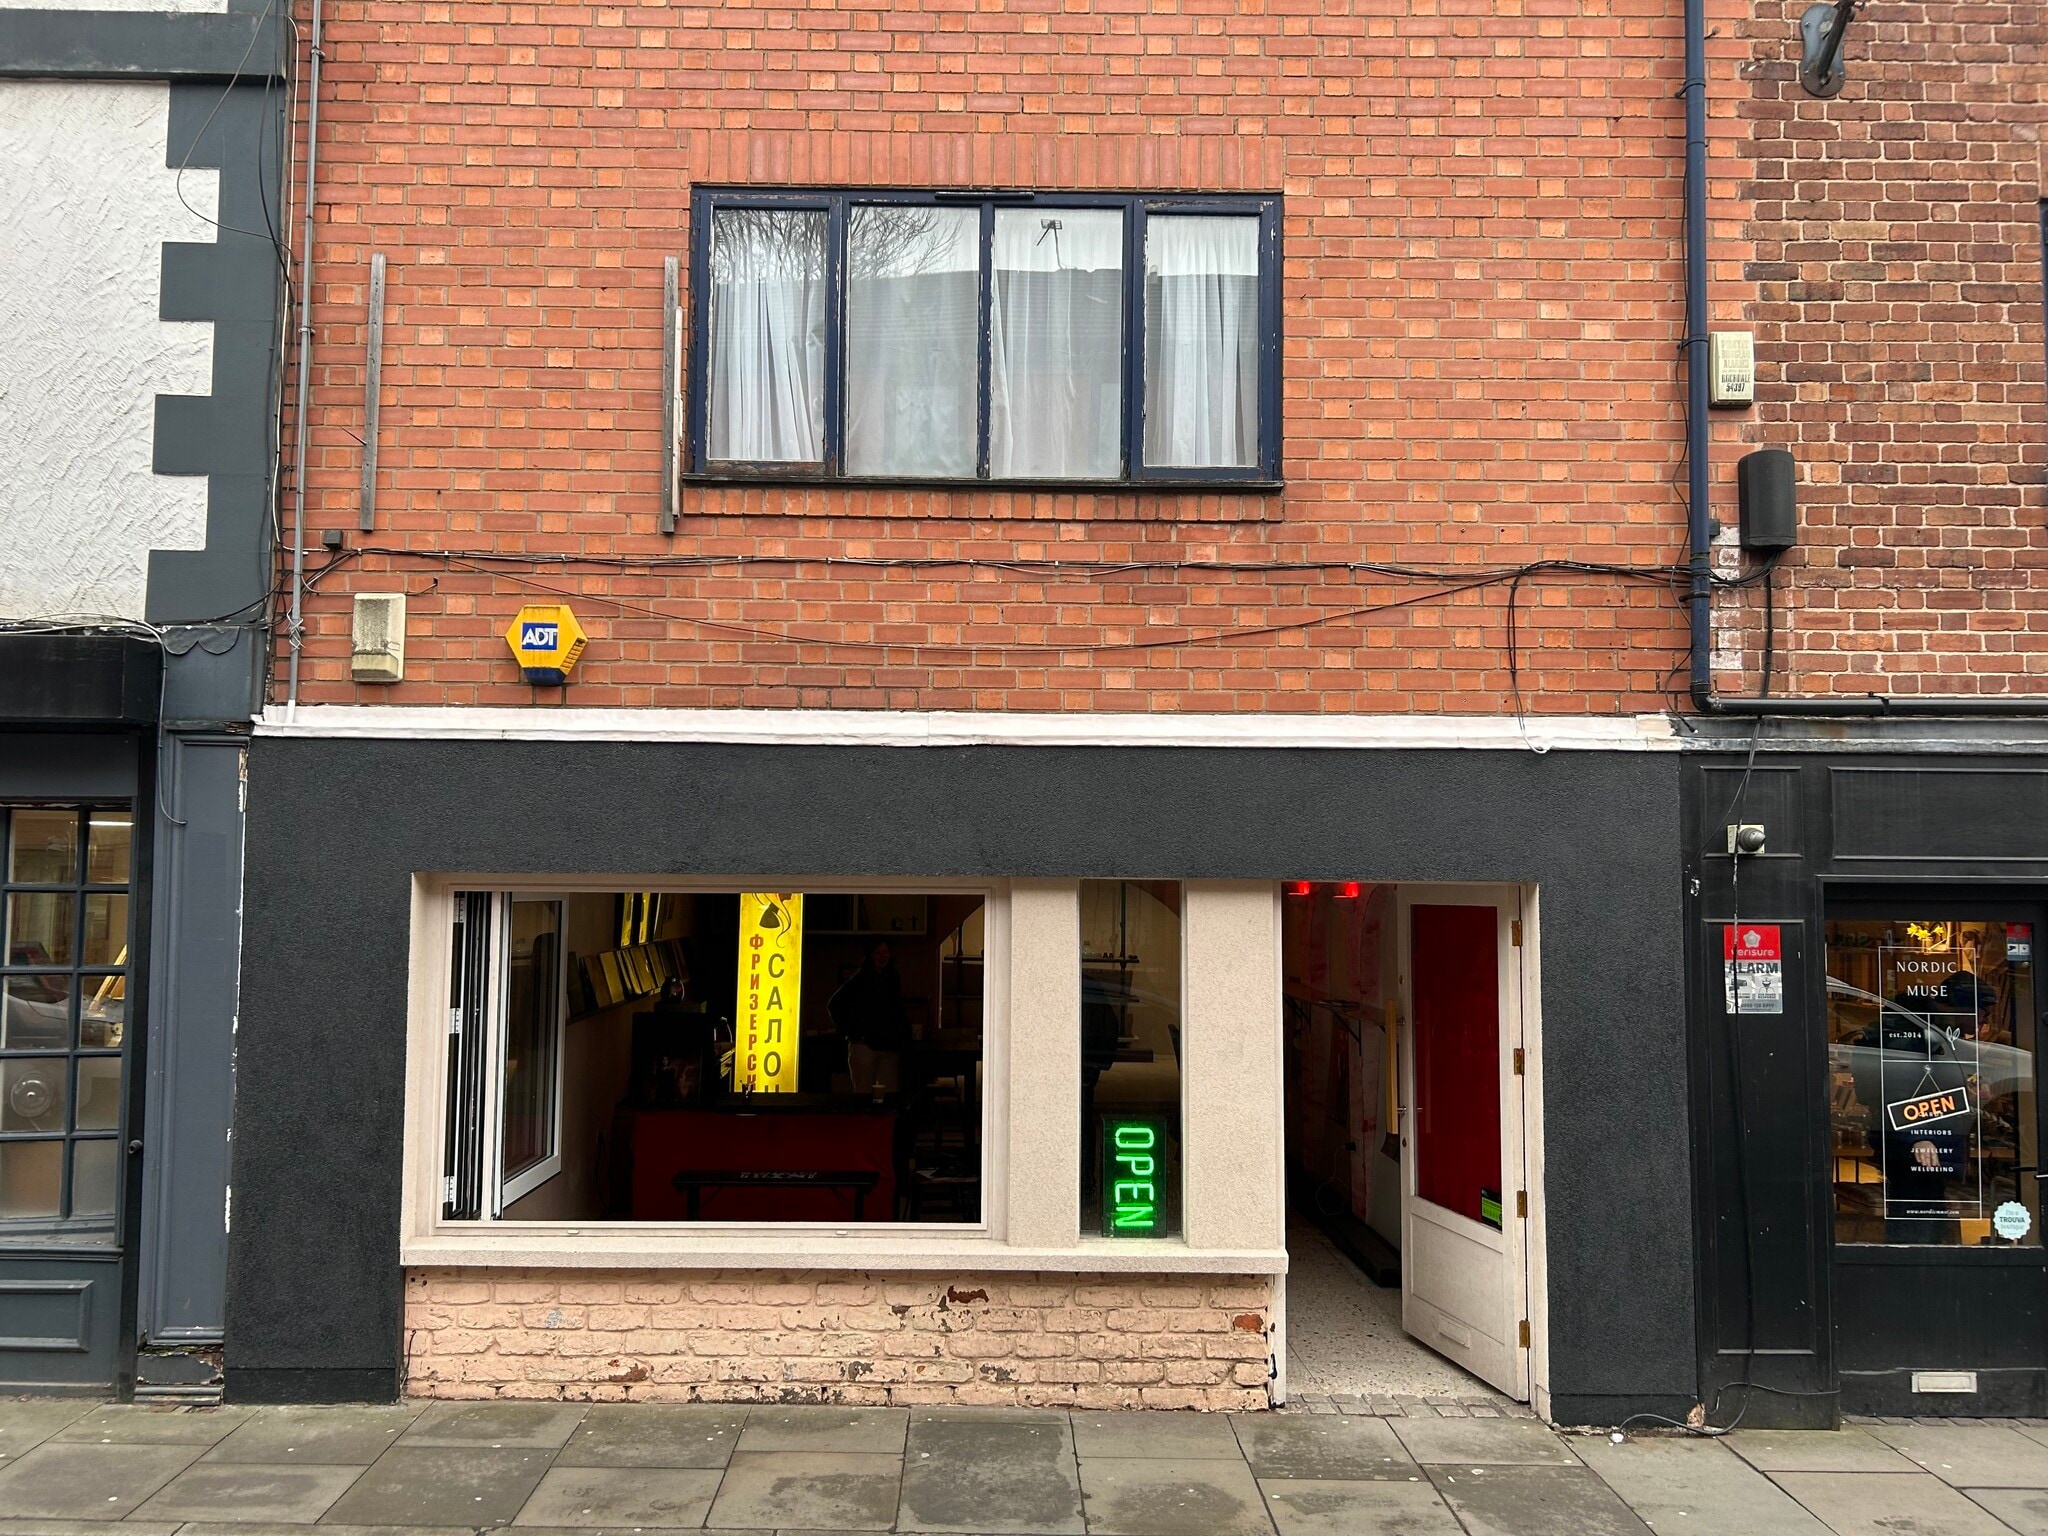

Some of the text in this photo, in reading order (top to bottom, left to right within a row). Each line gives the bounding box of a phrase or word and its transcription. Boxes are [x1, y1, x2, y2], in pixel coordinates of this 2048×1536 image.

[522, 627, 558, 646] ADT
[1728, 963, 1778, 973] ALARM
[1896, 961, 1957, 973] NORDIC
[1907, 985, 1948, 997] MUSE
[1903, 1095, 1955, 1120] OPEN
[1115, 1128, 1154, 1226] OPEN
